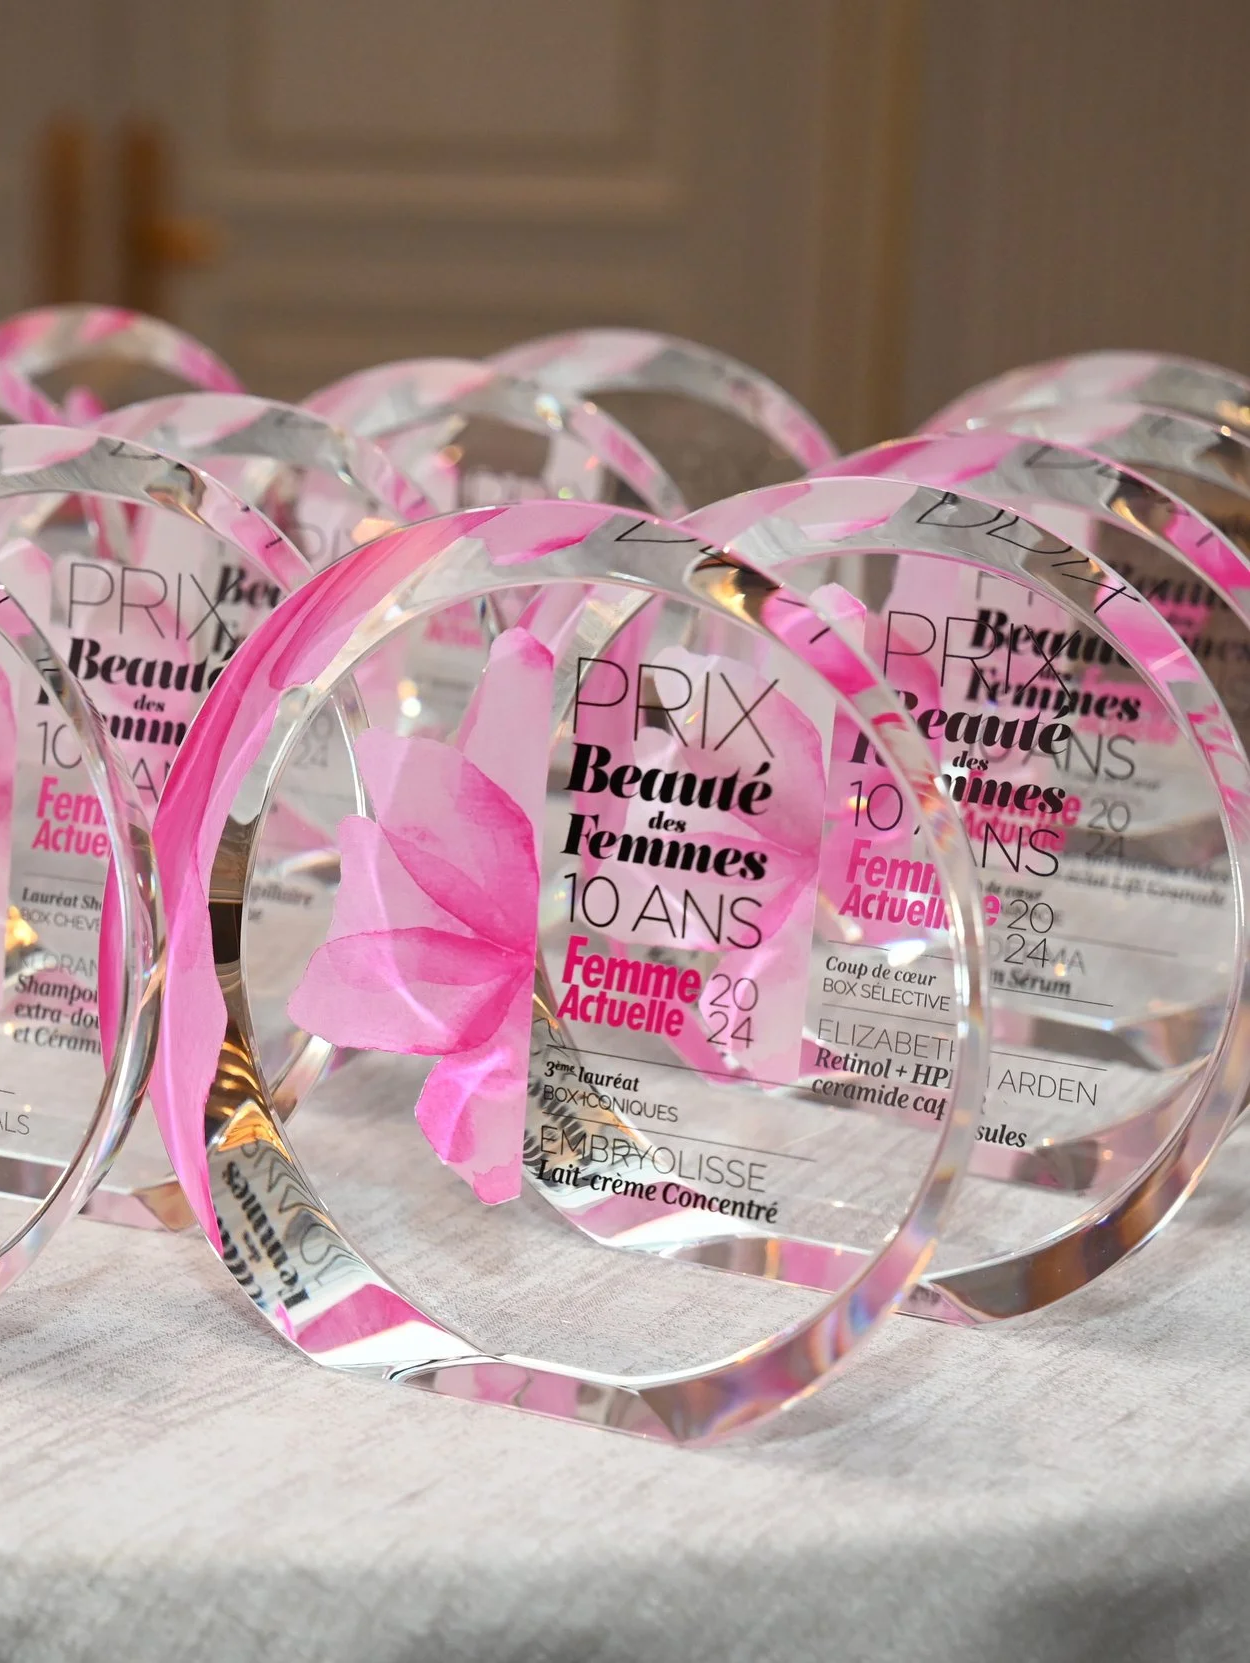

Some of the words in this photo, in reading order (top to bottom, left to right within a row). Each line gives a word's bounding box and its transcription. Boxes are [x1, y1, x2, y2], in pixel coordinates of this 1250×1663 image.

[68, 562, 238, 645] PRIX
[883, 610, 1080, 699] PRIX
[133, 694, 165, 712] des
[573, 657, 780, 758] PRIX
[564, 742, 773, 816] Beauté
[952, 751, 990, 771] des
[36, 775, 108, 824] Fem
[850, 780, 903, 831] 10
[32, 820, 112, 858] Actue
[648, 811, 687, 833] des
[560, 813, 768, 881] Femmes
[21, 886, 79, 908] Lauréat
[564, 872, 619, 928] 10
[632, 884, 763, 949] ANS
[1007, 899, 1054, 933] 20
[20, 907, 51, 926] BOX
[1004, 933, 1050, 968] 24
[562, 935, 700, 1003] Femme
[709, 973, 759, 1011] 20
[826, 956, 869, 979] Coup
[871, 962, 890, 980] de
[893, 970, 937, 987] cœur
[823, 977, 856, 997] BOX
[861, 982, 950, 1012] SÉLECTIVE
[13, 1026, 30, 1043] et
[556, 984, 684, 1037] Actuelle
[707, 1010, 755, 1049] 24
[544, 1060, 576, 1079] 3ème
[578, 1065, 640, 1093] lauréat
[815, 1048, 890, 1079] Retinol
[895, 1066, 908, 1079] +
[543, 1084, 579, 1104] BOX
[581, 1089, 679, 1123] ICONIQUES
[812, 1079, 909, 1109] ceramide
[997, 1069, 1098, 1107] ARDEN
[540, 1124, 769, 1193] EMBRYOLISSE
[535, 1158, 657, 1202] Lait-crème
[661, 1181, 779, 1225] Concentré
